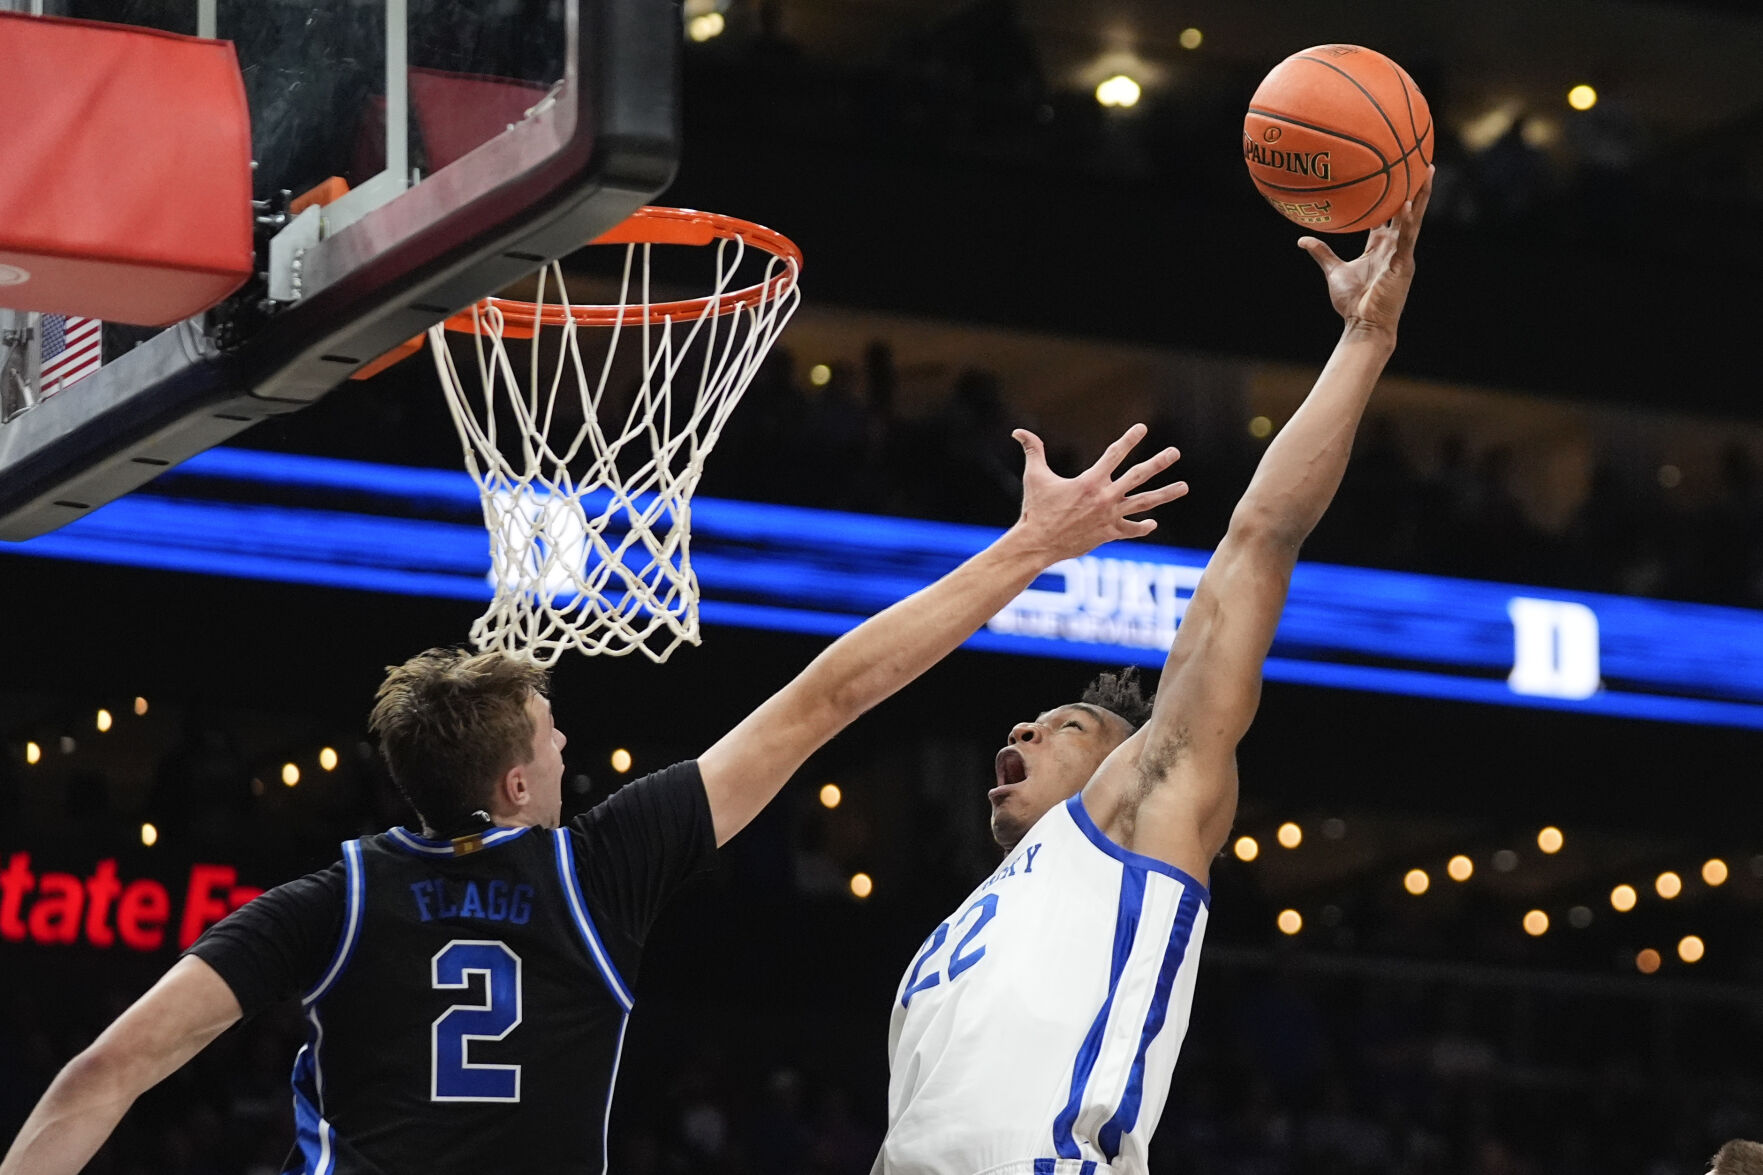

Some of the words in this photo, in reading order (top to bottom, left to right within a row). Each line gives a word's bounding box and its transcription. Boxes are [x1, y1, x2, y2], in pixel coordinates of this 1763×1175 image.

[1244, 139, 1331, 182] PALDING
[1507, 596, 1600, 701] D
[0, 852, 170, 951] tate
[410, 879, 535, 926] FLAGG
[901, 893, 999, 1009] 22
[431, 939, 522, 1102] 2
